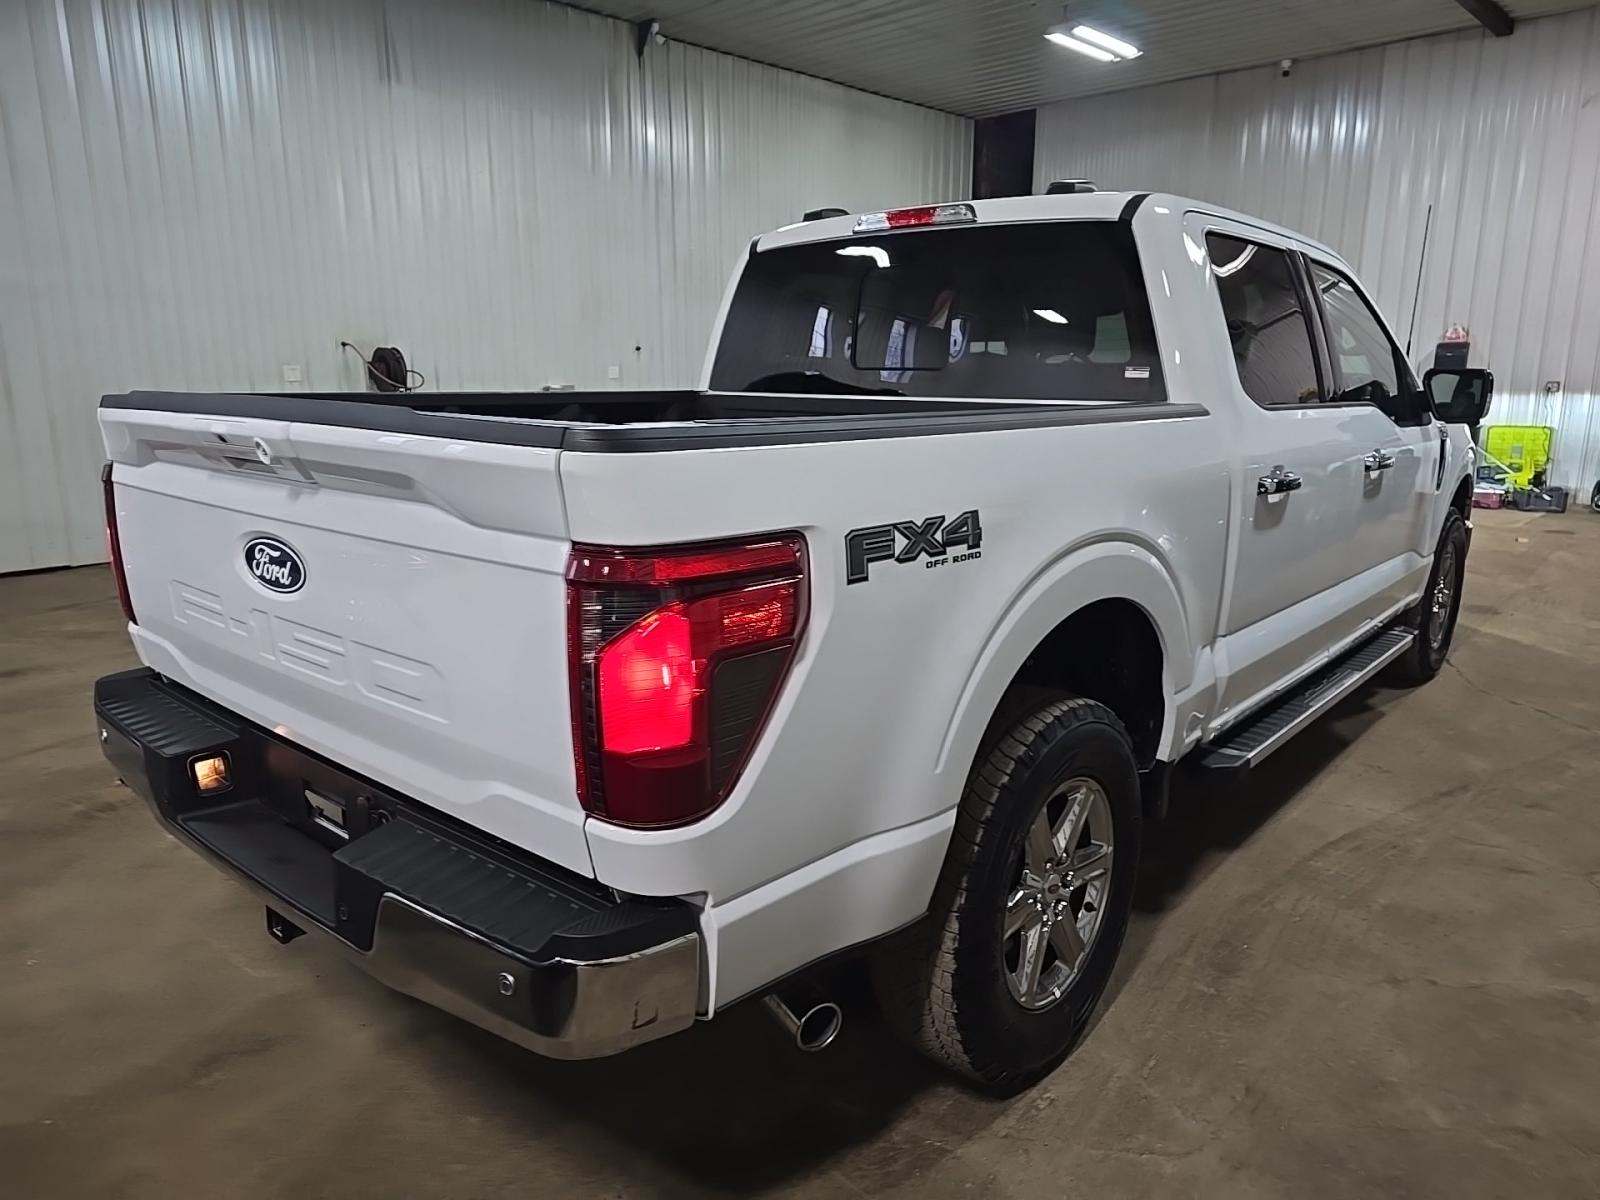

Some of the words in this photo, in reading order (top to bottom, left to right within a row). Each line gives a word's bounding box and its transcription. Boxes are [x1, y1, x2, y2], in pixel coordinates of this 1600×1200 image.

[253, 544, 292, 585] Ford
[845, 509, 982, 585] FX4
[925, 558, 948, 569] OFF
[952, 551, 982, 564] ROAD
[169, 579, 449, 724] F-150
